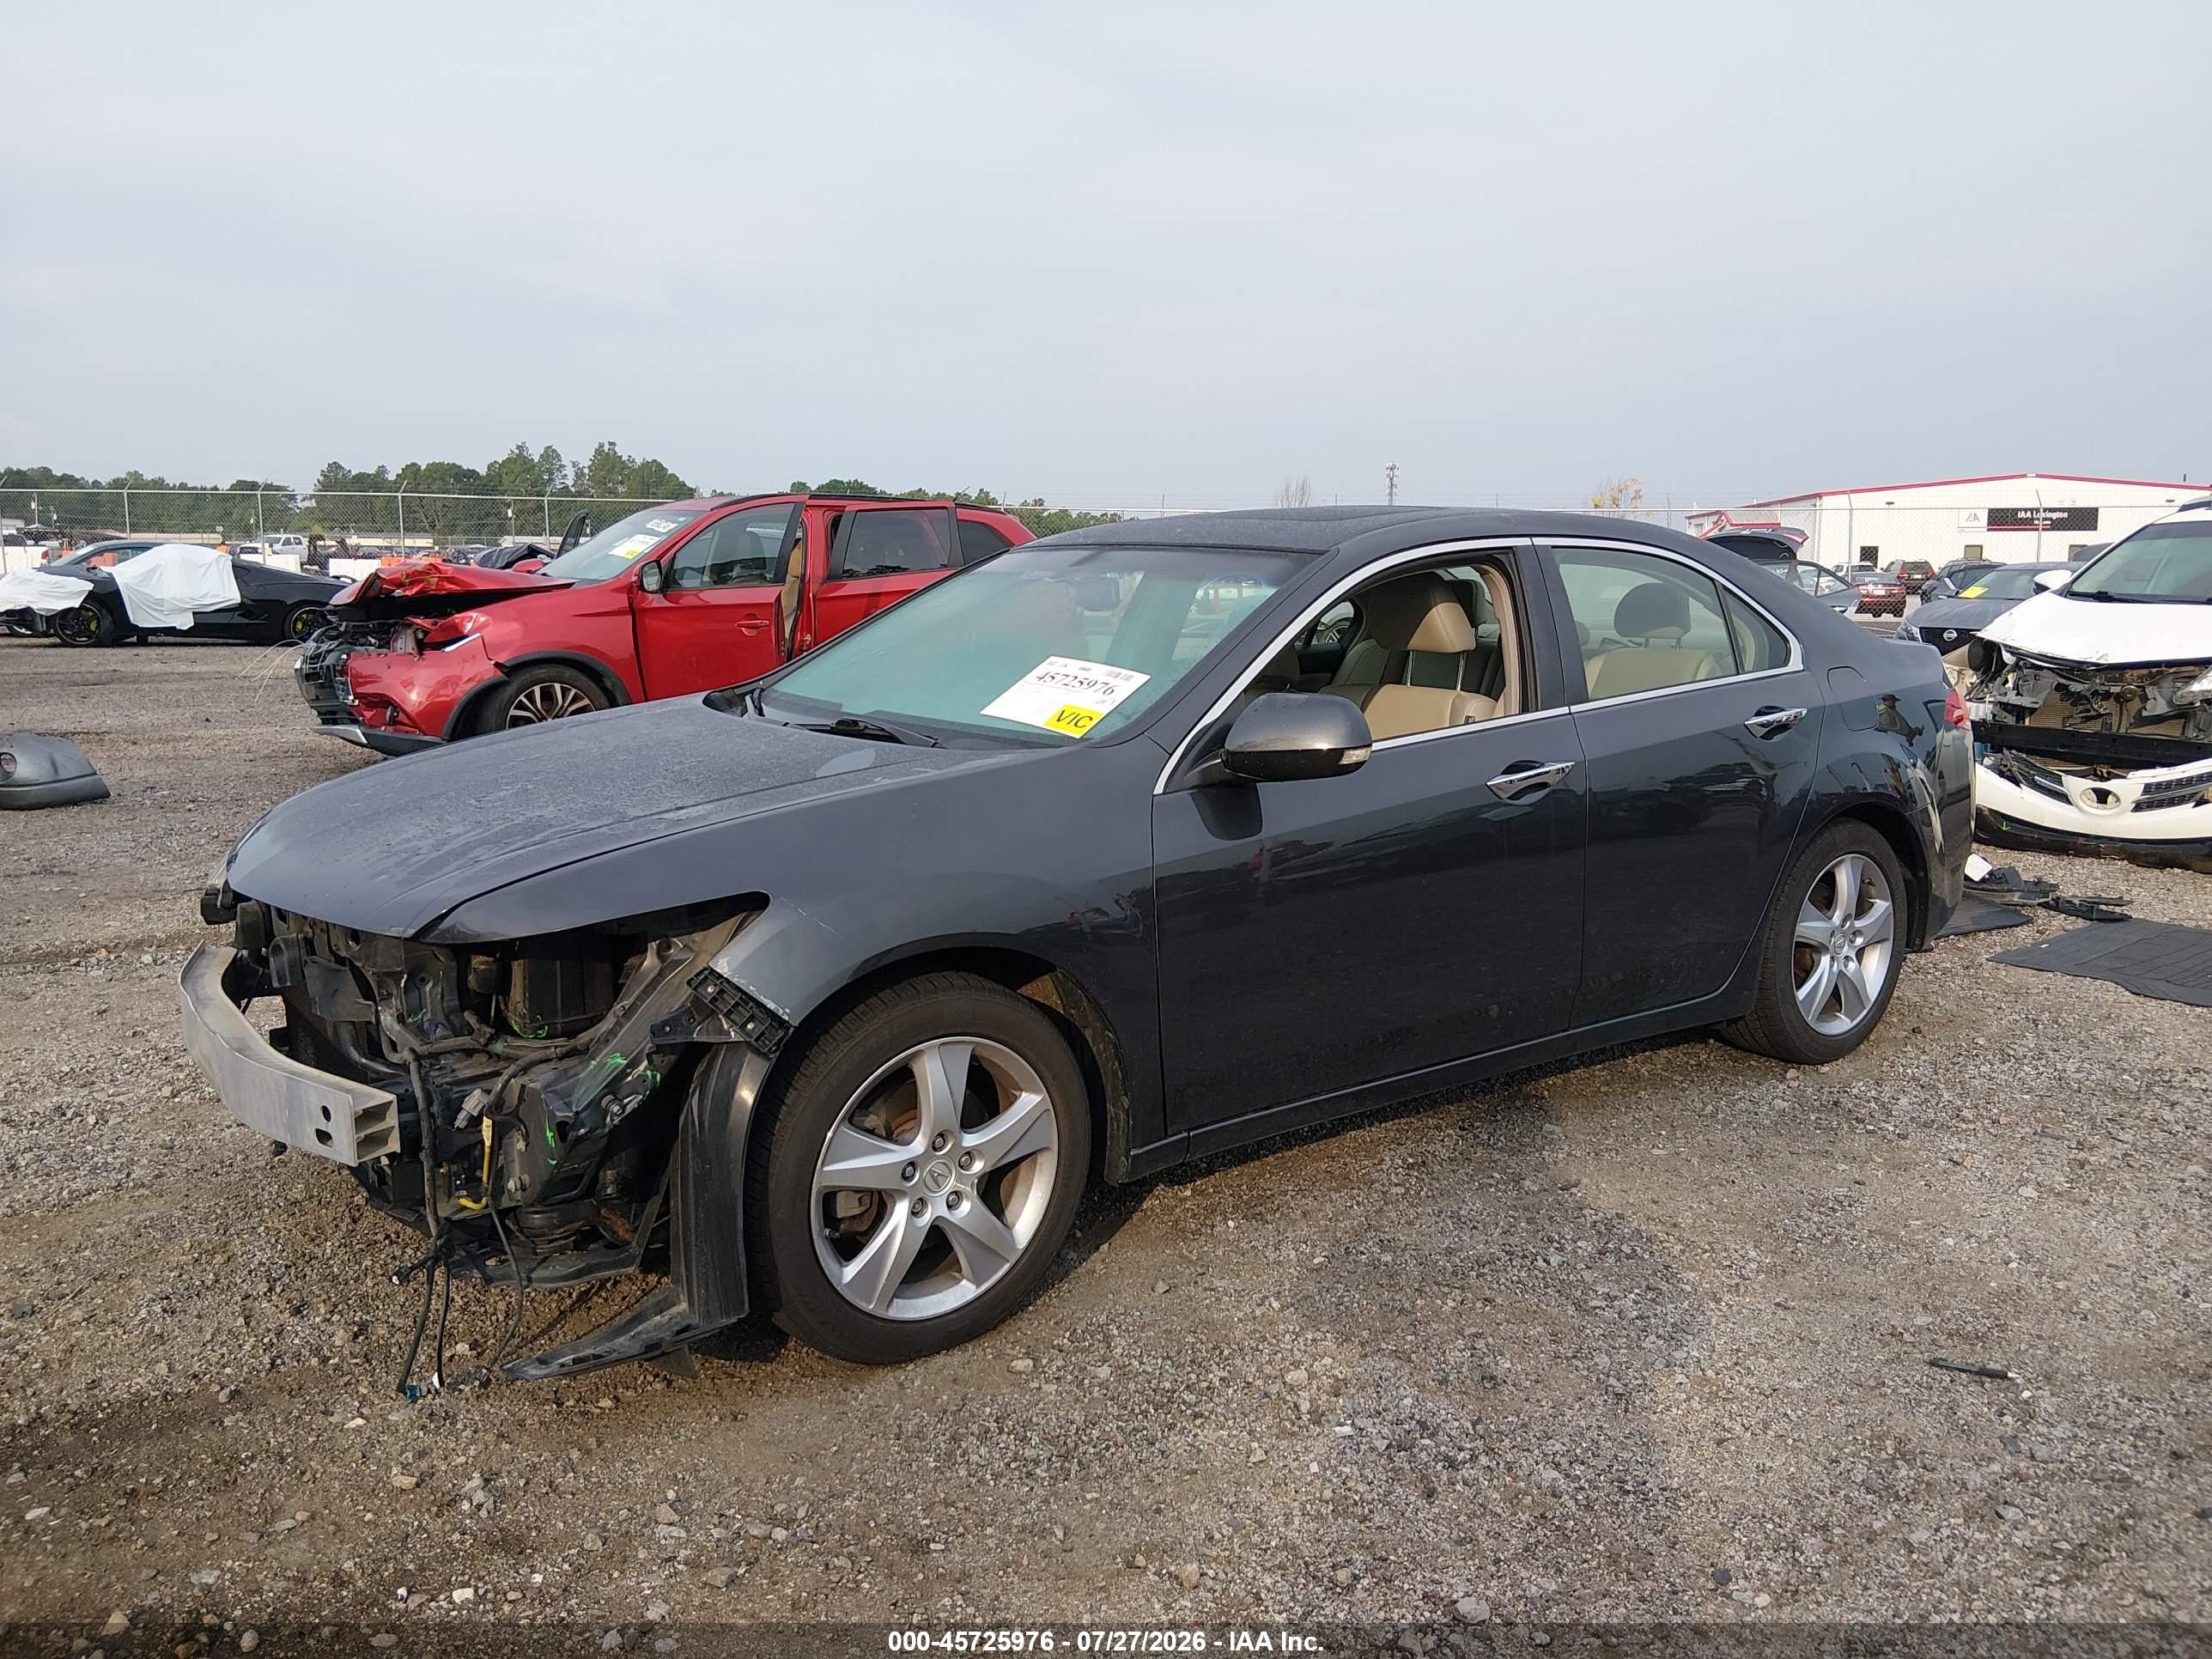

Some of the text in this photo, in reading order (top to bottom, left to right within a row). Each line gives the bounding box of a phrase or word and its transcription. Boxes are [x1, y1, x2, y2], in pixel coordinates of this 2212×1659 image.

[2018, 510, 2032, 519] IAA
[1036, 671, 1117, 696] 45725976
[1056, 709, 1094, 729] VIC
